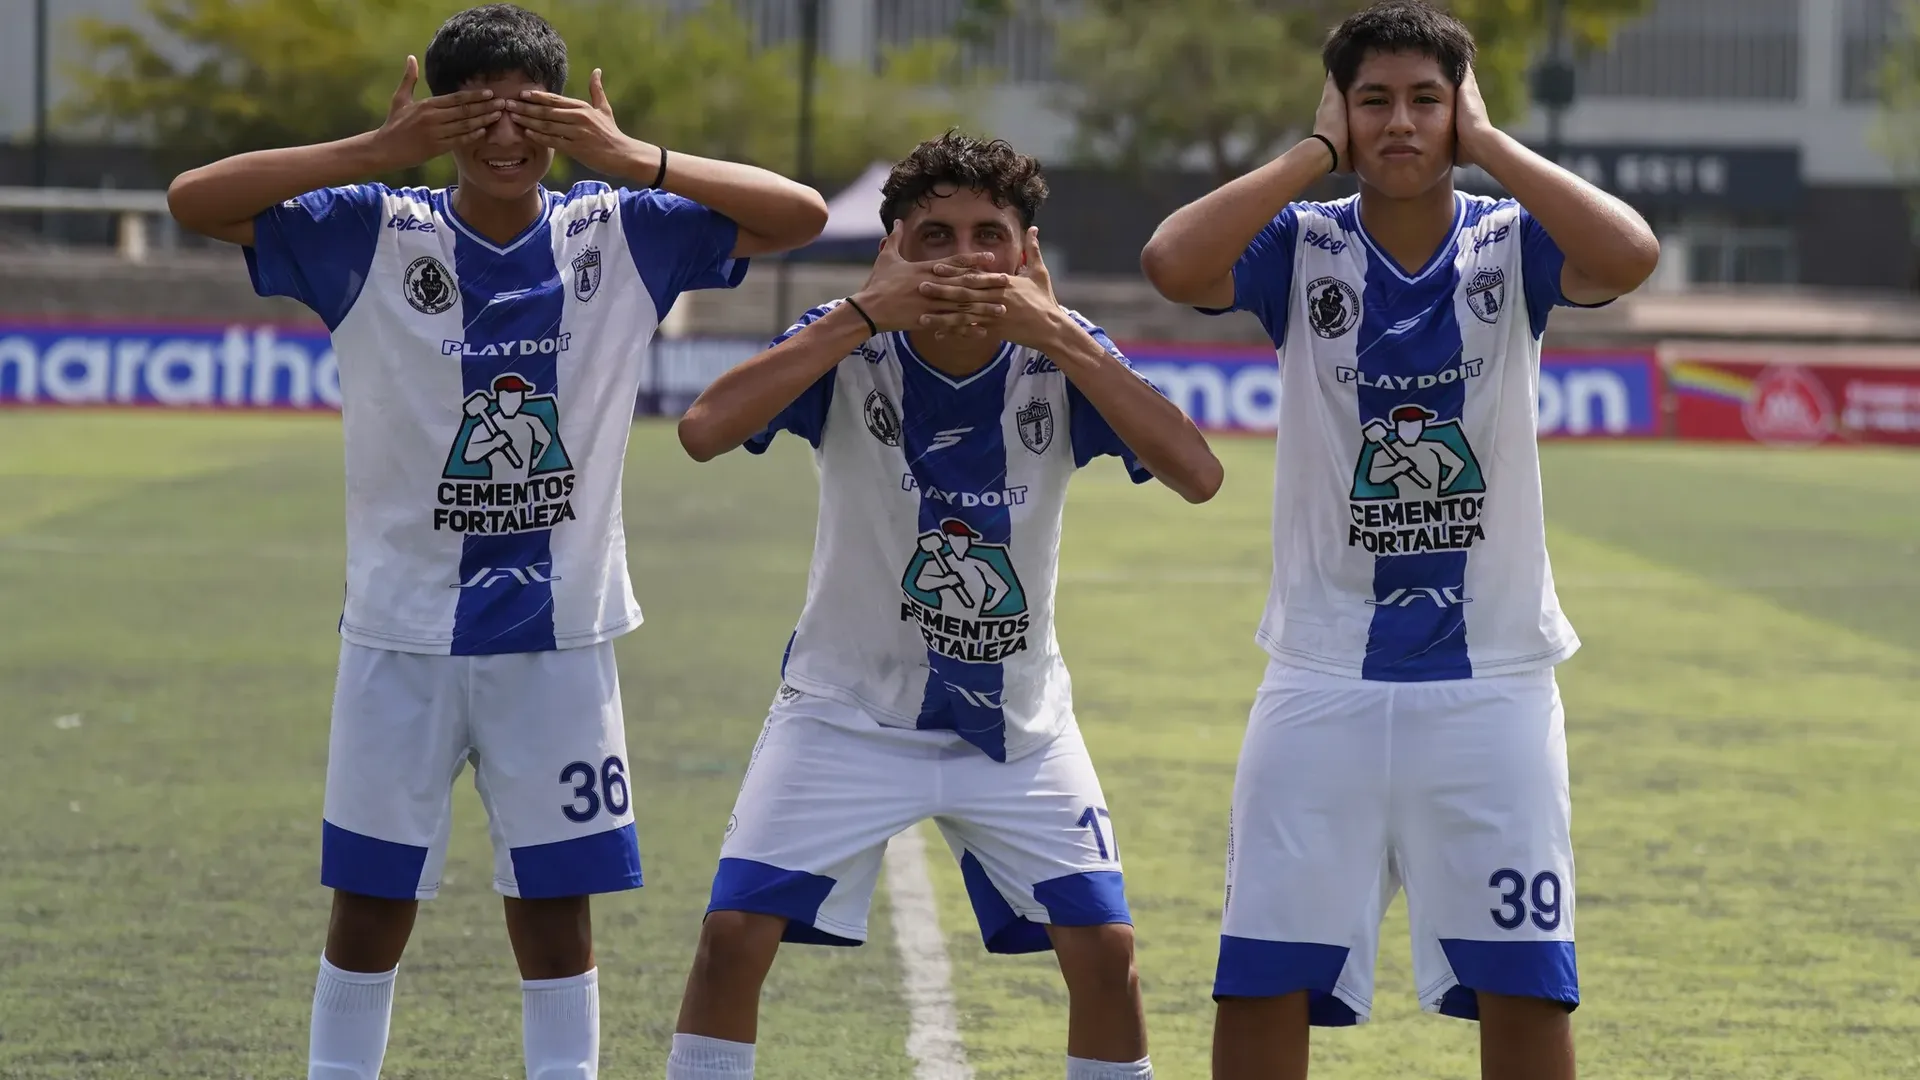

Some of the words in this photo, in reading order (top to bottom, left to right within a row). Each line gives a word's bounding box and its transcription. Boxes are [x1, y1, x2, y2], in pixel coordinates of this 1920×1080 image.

[387, 214, 436, 233] telce
[1304, 228, 1347, 255] elcel
[0, 324, 344, 408] arath
[437, 474, 576, 507] CEMENTOS
[902, 473, 1028, 508] PAYDOIT
[433, 499, 577, 534] FORTALEZA
[1349, 522, 1486, 555] FORTALEZA
[904, 597, 1030, 641] EMENTOS
[559, 755, 629, 824] 36
[1075, 805, 1119, 862] 17
[1488, 867, 1562, 932] 39
